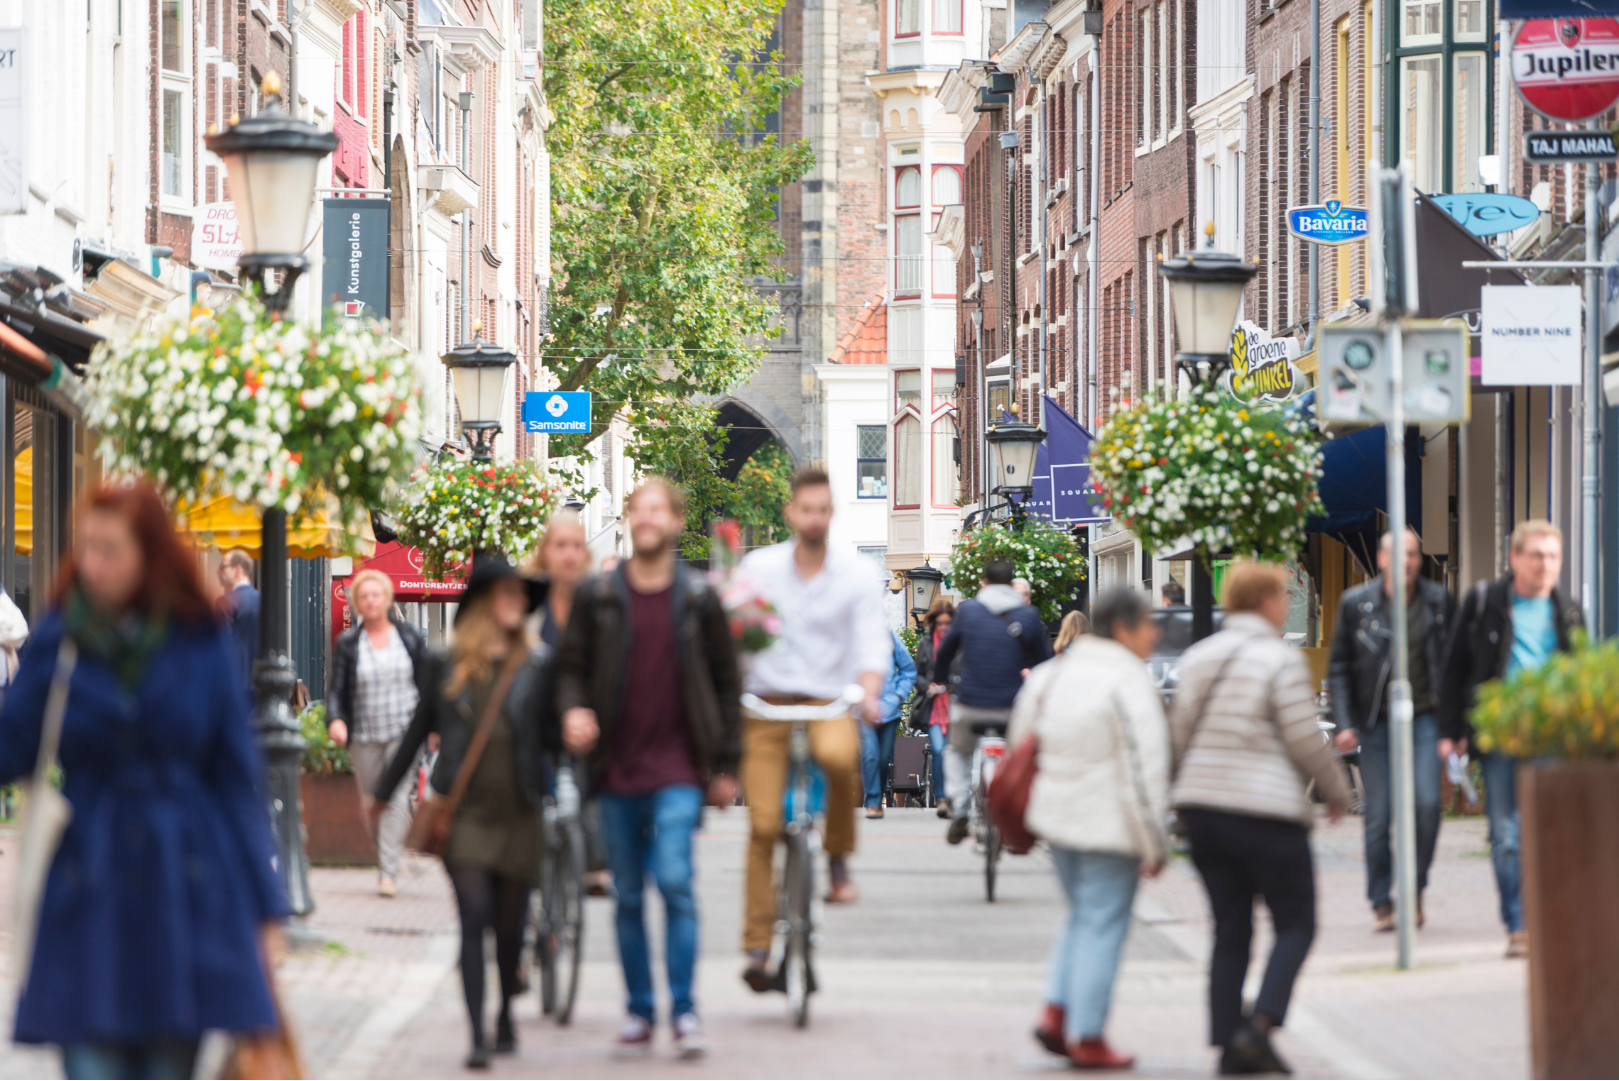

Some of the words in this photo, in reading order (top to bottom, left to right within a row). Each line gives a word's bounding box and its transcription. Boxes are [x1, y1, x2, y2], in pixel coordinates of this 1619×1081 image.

[1530, 138, 1558, 155] TAJ
[1561, 137, 1616, 154] MAHAL
[1299, 215, 1367, 231] Bavaria
[347, 212, 362, 294] Kunstgalerie
[1248, 331, 1259, 346] de
[1492, 327, 1540, 336] NUMBER
[1544, 327, 1571, 336] NINE
[1249, 340, 1287, 368] groene
[529, 420, 587, 430] Samsonite
